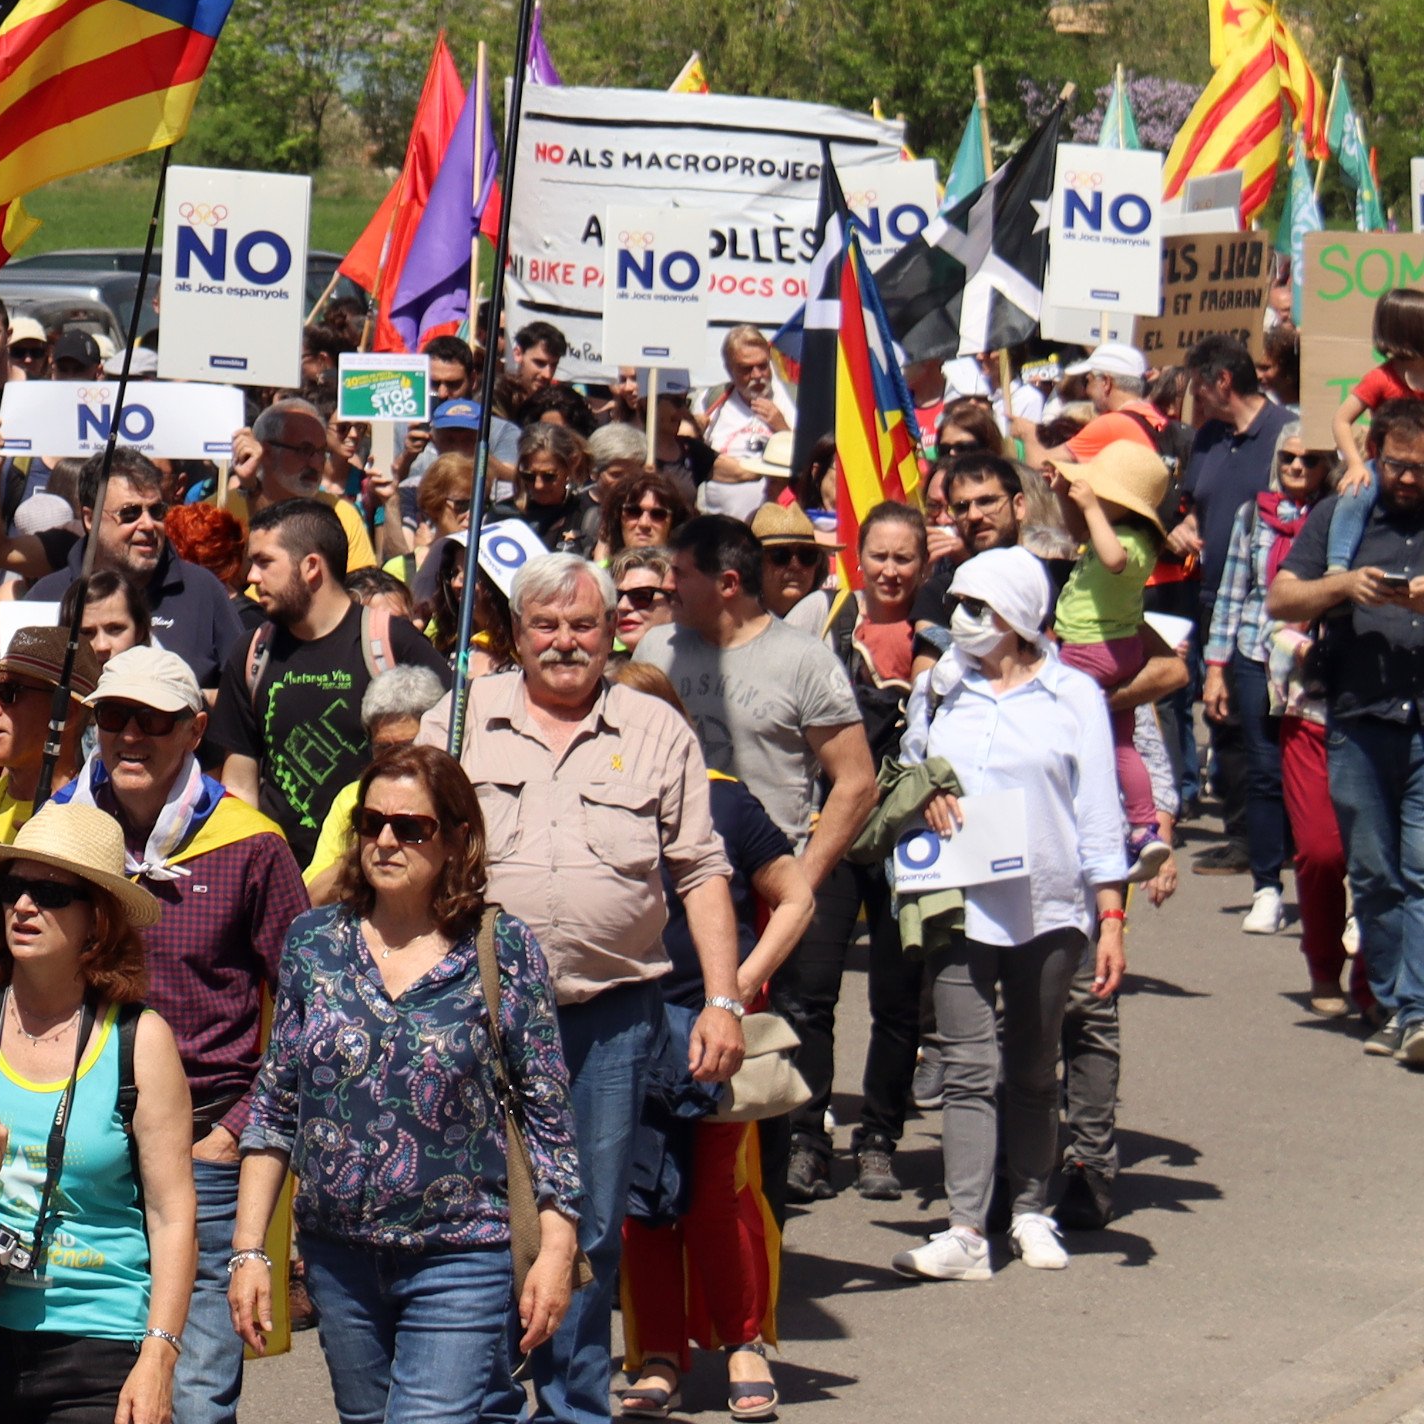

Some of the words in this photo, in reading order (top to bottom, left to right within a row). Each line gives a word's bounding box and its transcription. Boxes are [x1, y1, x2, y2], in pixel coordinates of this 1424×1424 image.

[535, 143, 564, 164] NO
[567, 148, 613, 169] ALS
[847, 204, 928, 245] NO
[1062, 188, 1151, 235] NO
[1079, 233, 1100, 242] Jocs
[1101, 236, 1150, 247] espanyols
[175, 225, 292, 286] NO
[530, 259, 576, 286] BIKE
[617, 249, 700, 292] NO
[175, 282, 191, 292] als
[195, 282, 223, 295] Jocs
[226, 287, 289, 299] espanyols
[631, 292, 652, 300] Jocs
[654, 294, 699, 303] espanyols
[1173, 292, 1192, 315] ET
[1200, 288, 1263, 312] PAGARAN
[1143, 330, 1163, 351] EL
[371, 388, 413, 408] STOP
[77, 403, 155, 442] NO
[332, 669, 351, 682] Viva
[897, 827, 941, 871] O
